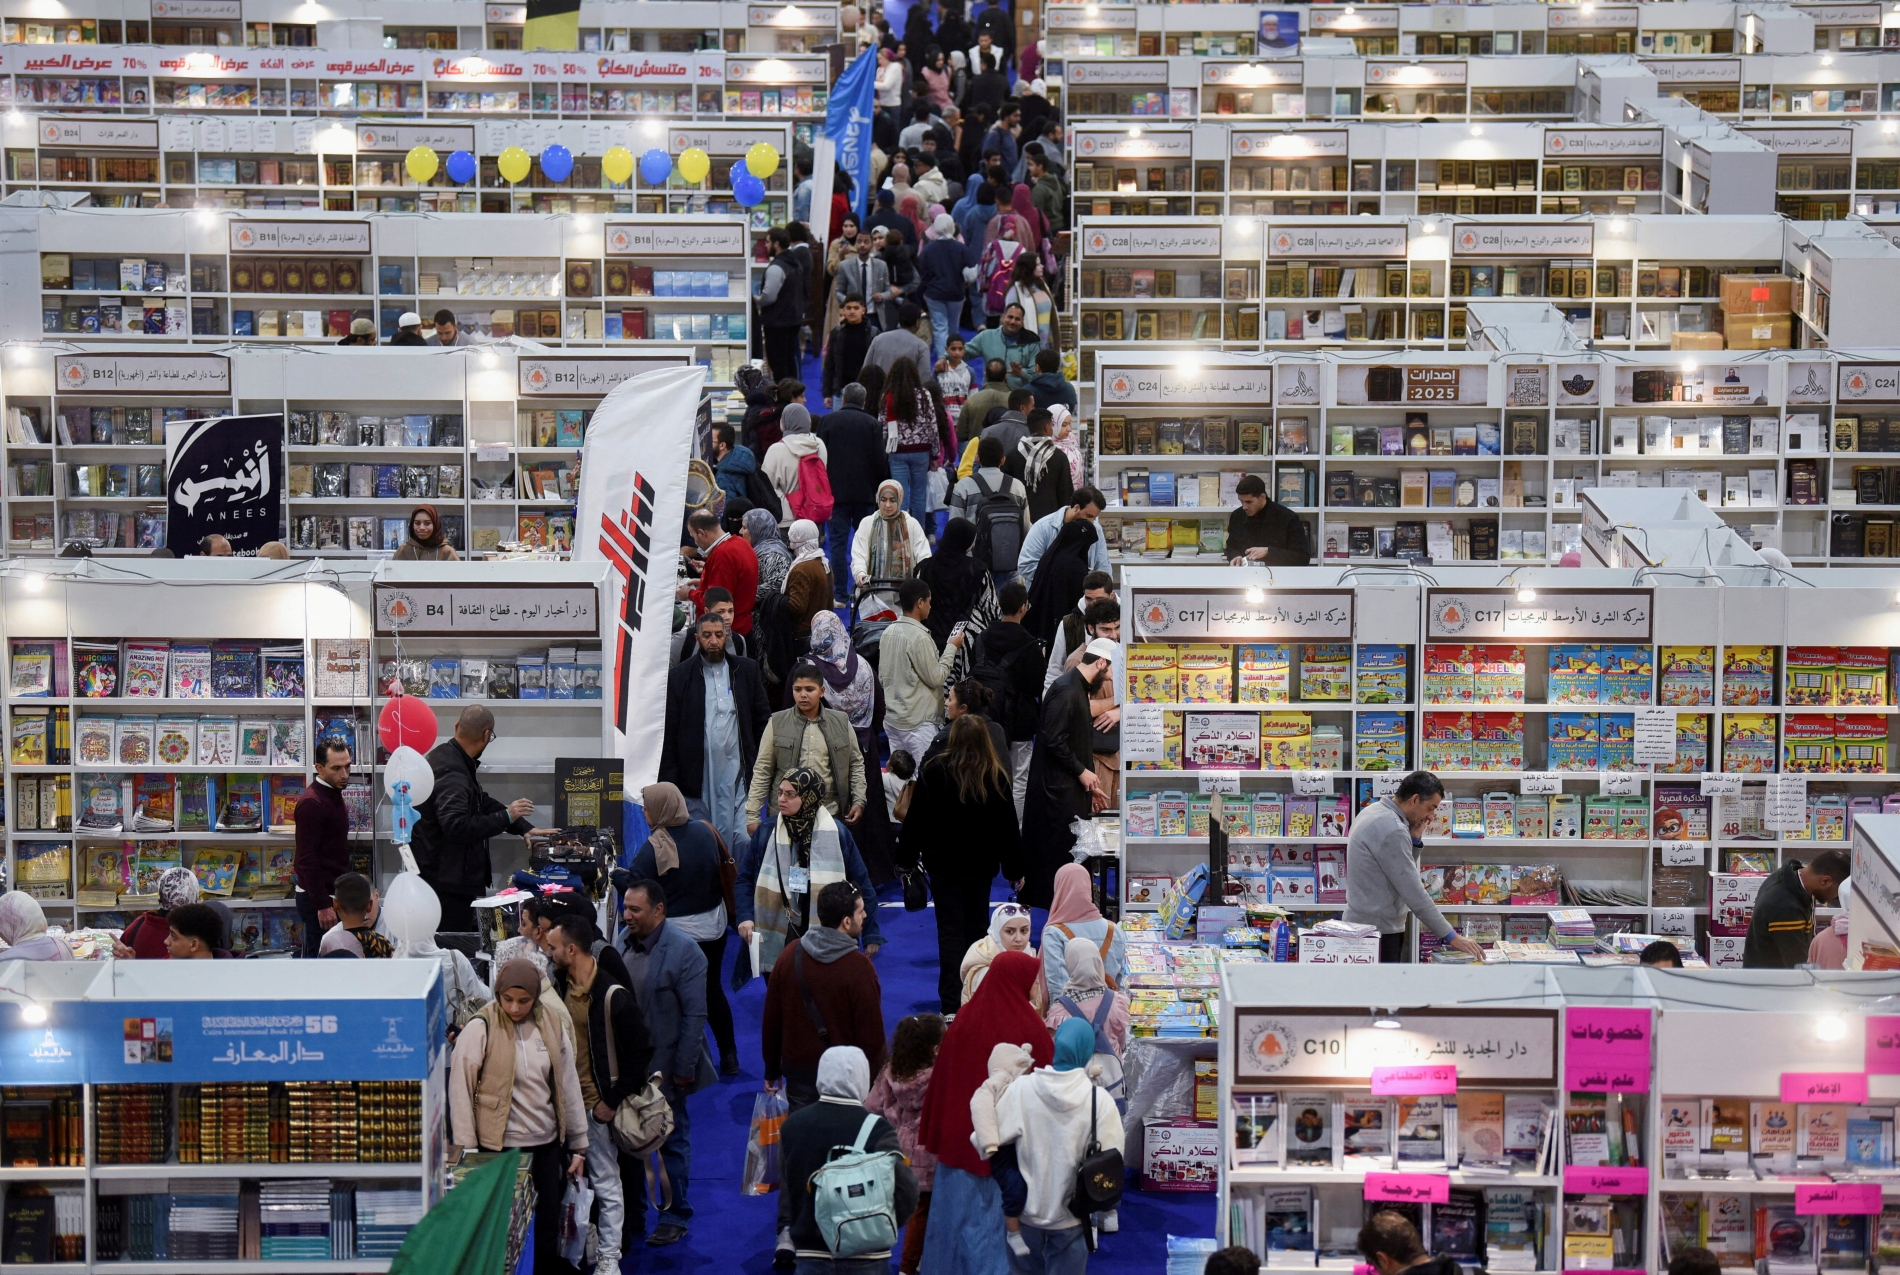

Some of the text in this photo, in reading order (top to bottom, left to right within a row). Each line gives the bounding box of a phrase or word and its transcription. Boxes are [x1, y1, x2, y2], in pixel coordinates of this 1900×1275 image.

[24, 54, 112, 71] عرض الكبير
[122, 57, 147, 69] 70%
[220, 58, 248, 71] عرض
[291, 59, 315, 69] عرض
[352, 59, 386, 75] الكبير
[386, 61, 414, 75] عرض
[533, 64, 557, 75] 70%
[563, 63, 587, 75] 50%
[633, 60, 687, 77] متنساش
[699, 66, 722, 77] 20%
[1100, 141, 1114, 149] C33
[1255, 141, 1269, 149] C33
[260, 233, 276, 241] B18
[280, 233, 358, 246] الحضارة للنشر والتوزيع (السعودية)
[635, 236, 651, 244] B18
[655, 236, 731, 249] الحضارة للنشر والتوزيع (السعودية)
[1112, 238, 1129, 246] C28
[1297, 238, 1314, 246] C28
[1482, 236, 1499, 244] C28
[1503, 236, 1529, 247] (السعودية)
[1531, 236, 1549, 248] والتوزيع
[1550, 236, 1562, 247] للنشر
[1133, 238, 1158, 249] (السعودية)
[1160, 238, 1178, 250] والتوزيع
[1179, 238, 1191, 248] للنشر
[1318, 238, 1343, 249] (السعودية)
[1345, 238, 1363, 250] والتوزيع
[1364, 238, 1376, 248] للنشر
[93, 370, 114, 379] B12
[118, 370, 226, 382] مؤسسة دار التحرير للطباعة والنشر (الجمهورية)
[555, 374, 575, 382] B12
[579, 374, 605, 385] (الجمهورية)
[607, 374, 622, 385] والنشر
[1410, 369, 1456, 384] إصدارات
[1138, 381, 1158, 391] C24
[1162, 381, 1267, 396] دار المذهب للطباعة والنشر والتوزيع
[1875, 379, 1896, 388] C24
[206, 508, 267, 522] ANEES
[426, 605, 445, 616] B4
[458, 600, 588, 621] دار أخبار اليوم قطاع الثقافة
[1178, 610, 1205, 622] C17
[1474, 610, 1501, 622] C17
[1211, 607, 1347, 626] شركة الشرق الأوسط للبرمجيات
[1507, 607, 1646, 626] شركة الشرق الأوسط للبرمجيات
[1437, 662, 1474, 673] HELLO
[1487, 662, 1525, 673] HELLO
[1675, 662, 1711, 673] Bonjour
[1735, 662, 1772, 673] Bonjour
[1191, 730, 1256, 743] الكلام الذكي
[1435, 730, 1473, 740] HELLO
[1485, 730, 1524, 741] HELLO
[1676, 732, 1706, 742] onjour
[1737, 732, 1774, 742] Bonjour
[1201, 776, 1218, 784] توظيف
[1607, 775, 1633, 785] الحواس
[1725, 776, 1741, 784] كروت
[1299, 786, 1326, 795] البصرية
[1526, 785, 1555, 793] المفردات
[1706, 787, 1736, 795] الكلام الذكي
[1659, 794, 1706, 804] الذاكرة البصرية
[1253, 804, 1282, 812] Numbers
[1486, 802, 1514, 810] Numbers
[1816, 808, 1845, 816] Numbers
[1722, 822, 1740, 835] 48
[1671, 842, 1694, 852] الذاكرة
[1271, 848, 1284, 861] A
[1669, 855, 1696, 864] البصرية
[1272, 881, 1285, 895] A
[1719, 892, 1751, 906] الذكي
[1662, 913, 1685, 921] الذاكرة
[1660, 924, 1687, 933] العبقرية
[305, 1015, 339, 1034] 56
[1571, 1023, 1644, 1044] خصومات
[1304, 1039, 1341, 1055] C10
[1426, 1040, 1457, 1060] للنشر
[1463, 1040, 1500, 1059] الجديد
[1506, 1041, 1528, 1059] دار
[212, 1040, 324, 1066] دار المعارف
[1578, 1073, 1635, 1090] علم نفس
[1807, 1083, 1841, 1098] الإعلام
[1150, 1144, 1185, 1159] الذكي
[1590, 1177, 1621, 1188] حضارة
[1381, 1180, 1432, 1198] برمجة
[1807, 1191, 1838, 1204] الشعر
